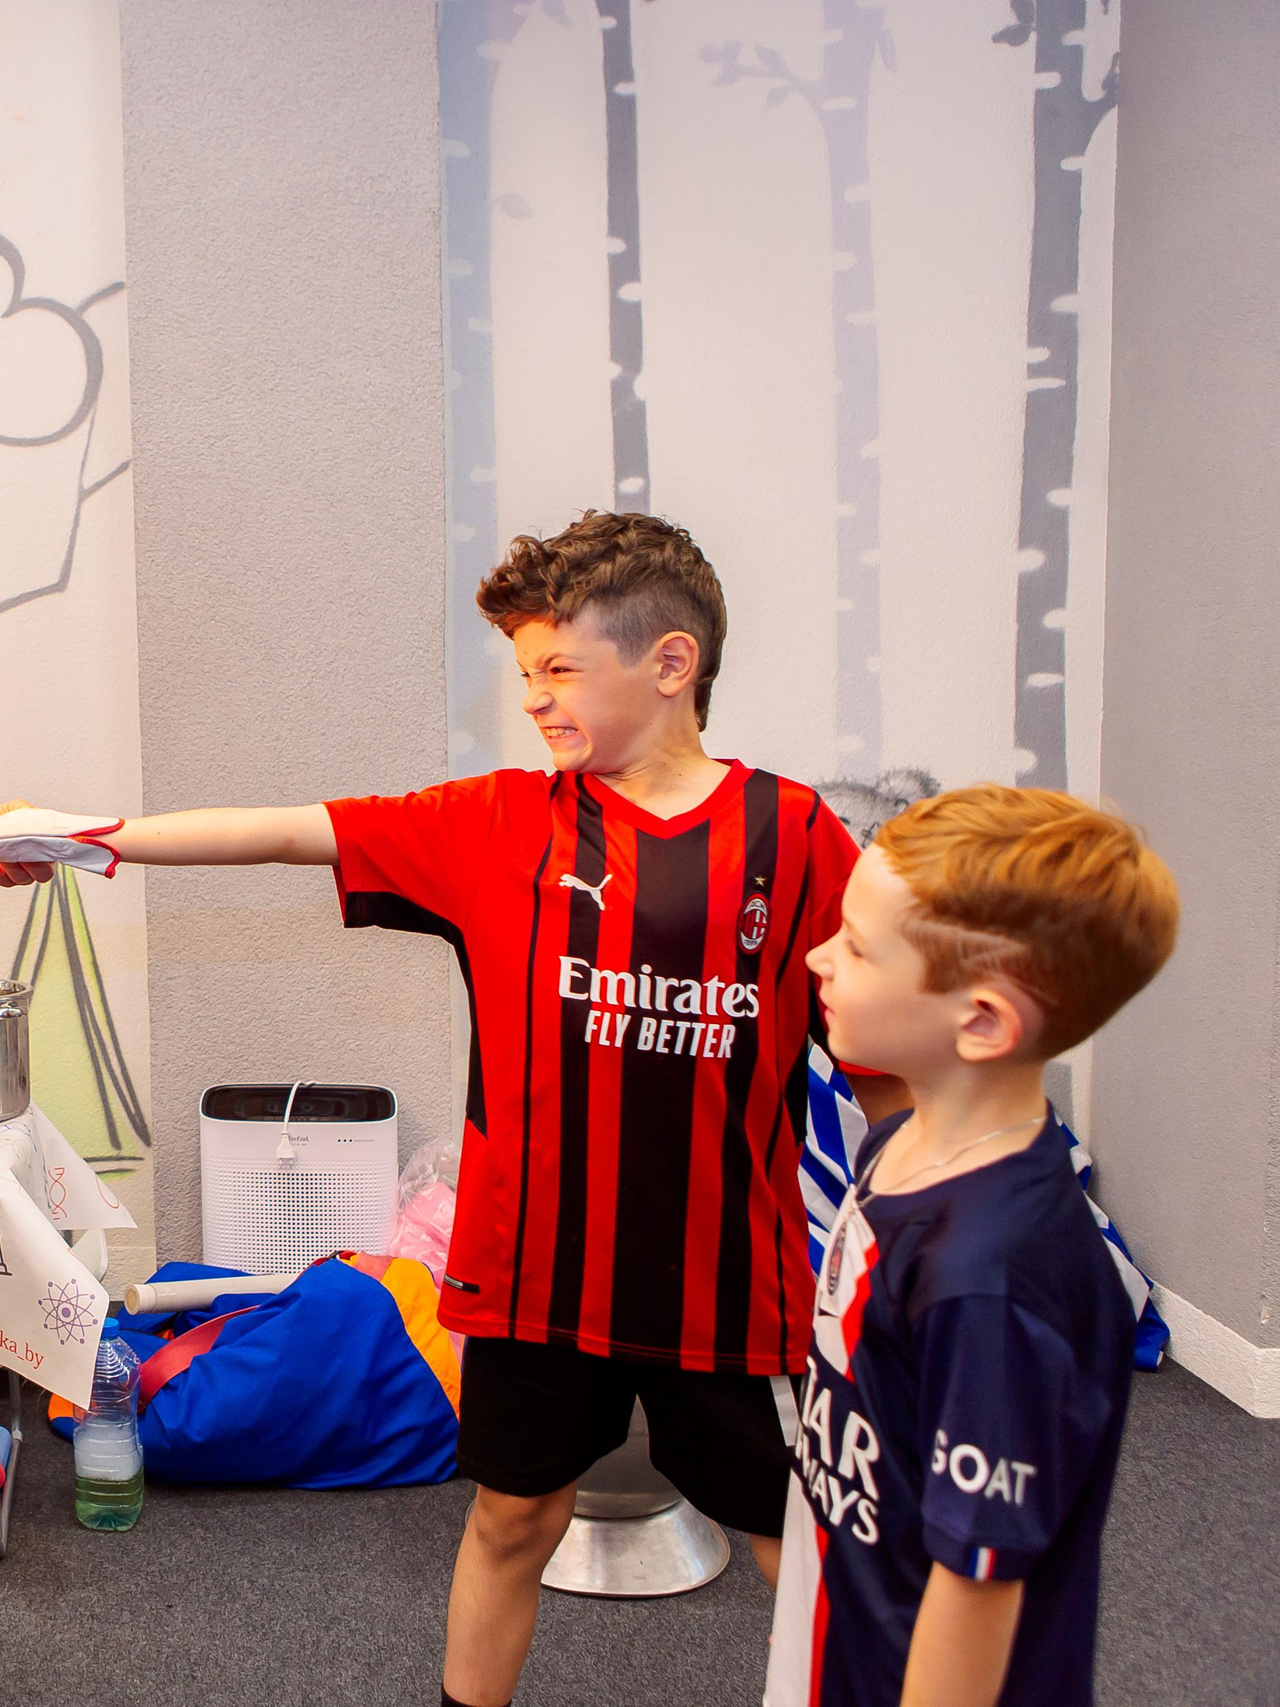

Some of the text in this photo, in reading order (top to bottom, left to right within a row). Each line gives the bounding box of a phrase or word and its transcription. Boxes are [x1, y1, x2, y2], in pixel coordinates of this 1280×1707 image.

[558, 956, 760, 1018] Emirates
[584, 1010, 736, 1059] FLY BETTER
